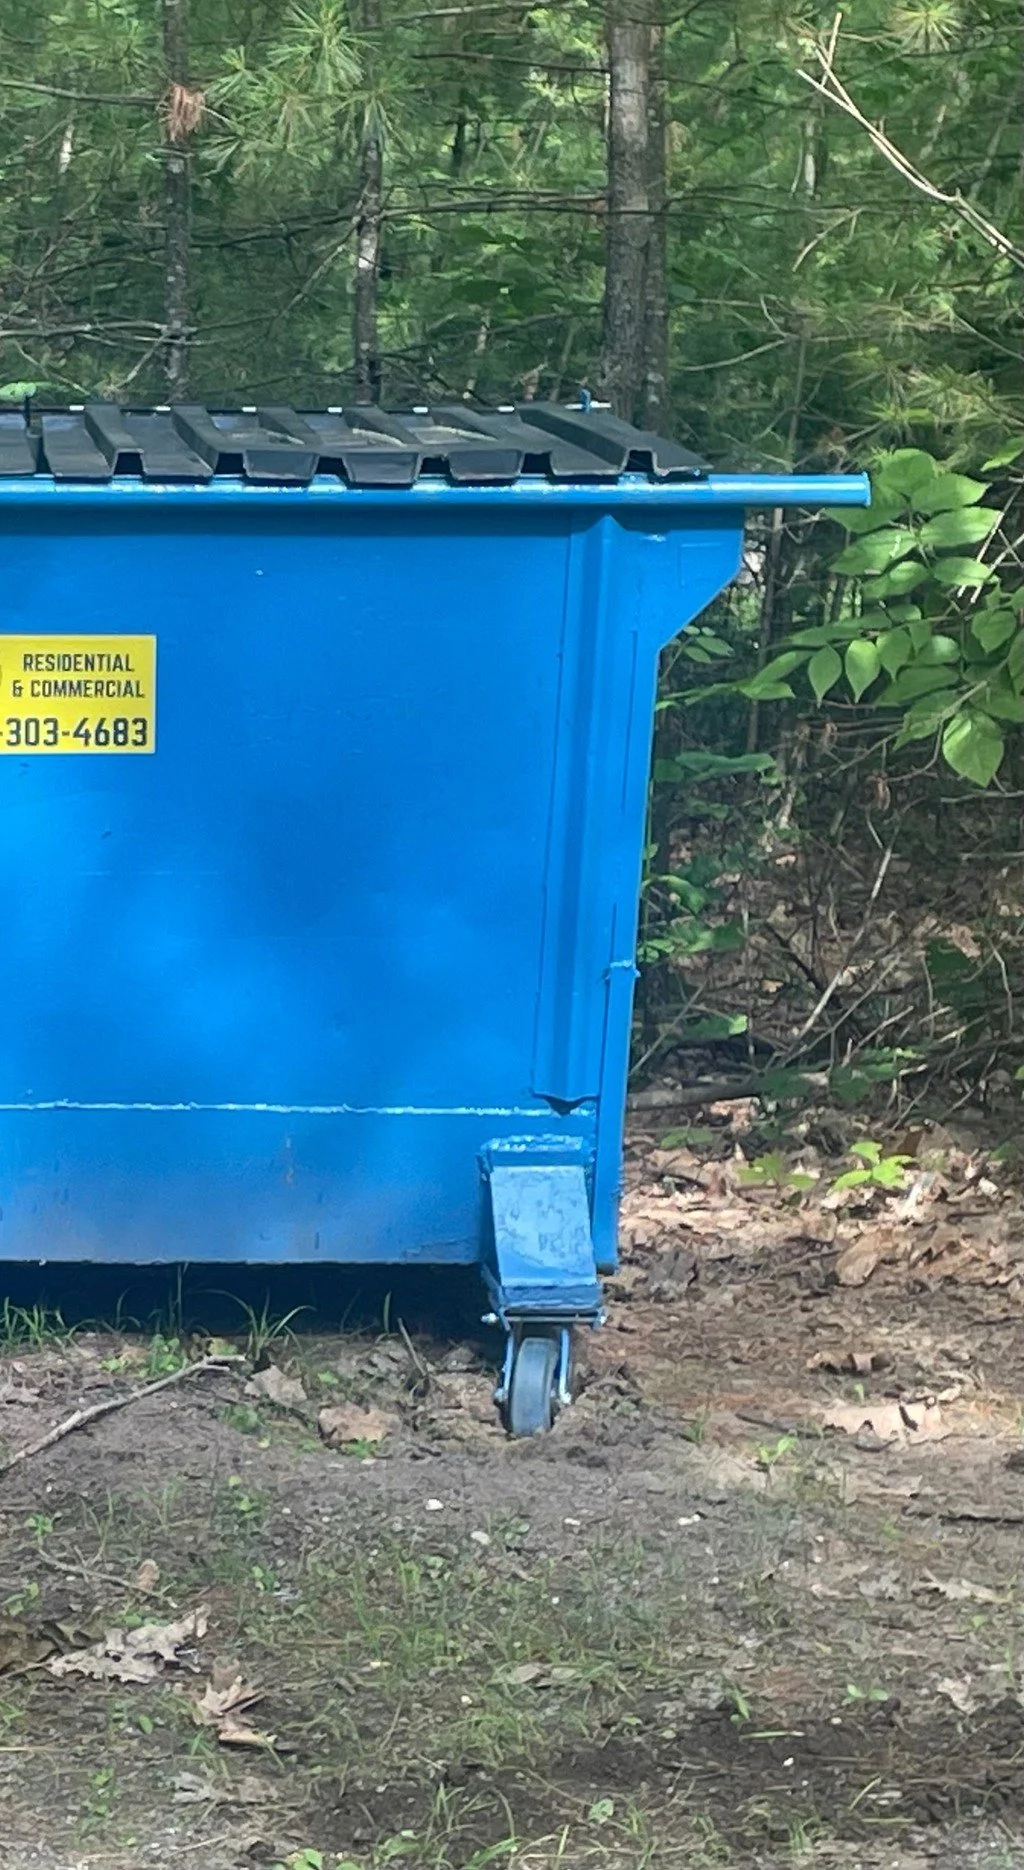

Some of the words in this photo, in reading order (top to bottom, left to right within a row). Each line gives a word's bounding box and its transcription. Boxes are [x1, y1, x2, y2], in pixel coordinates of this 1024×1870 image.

[23, 653, 135, 672] RESIDENTIAL
[12, 680, 24, 698] &
[30, 679, 146, 698] COMMERCIAL
